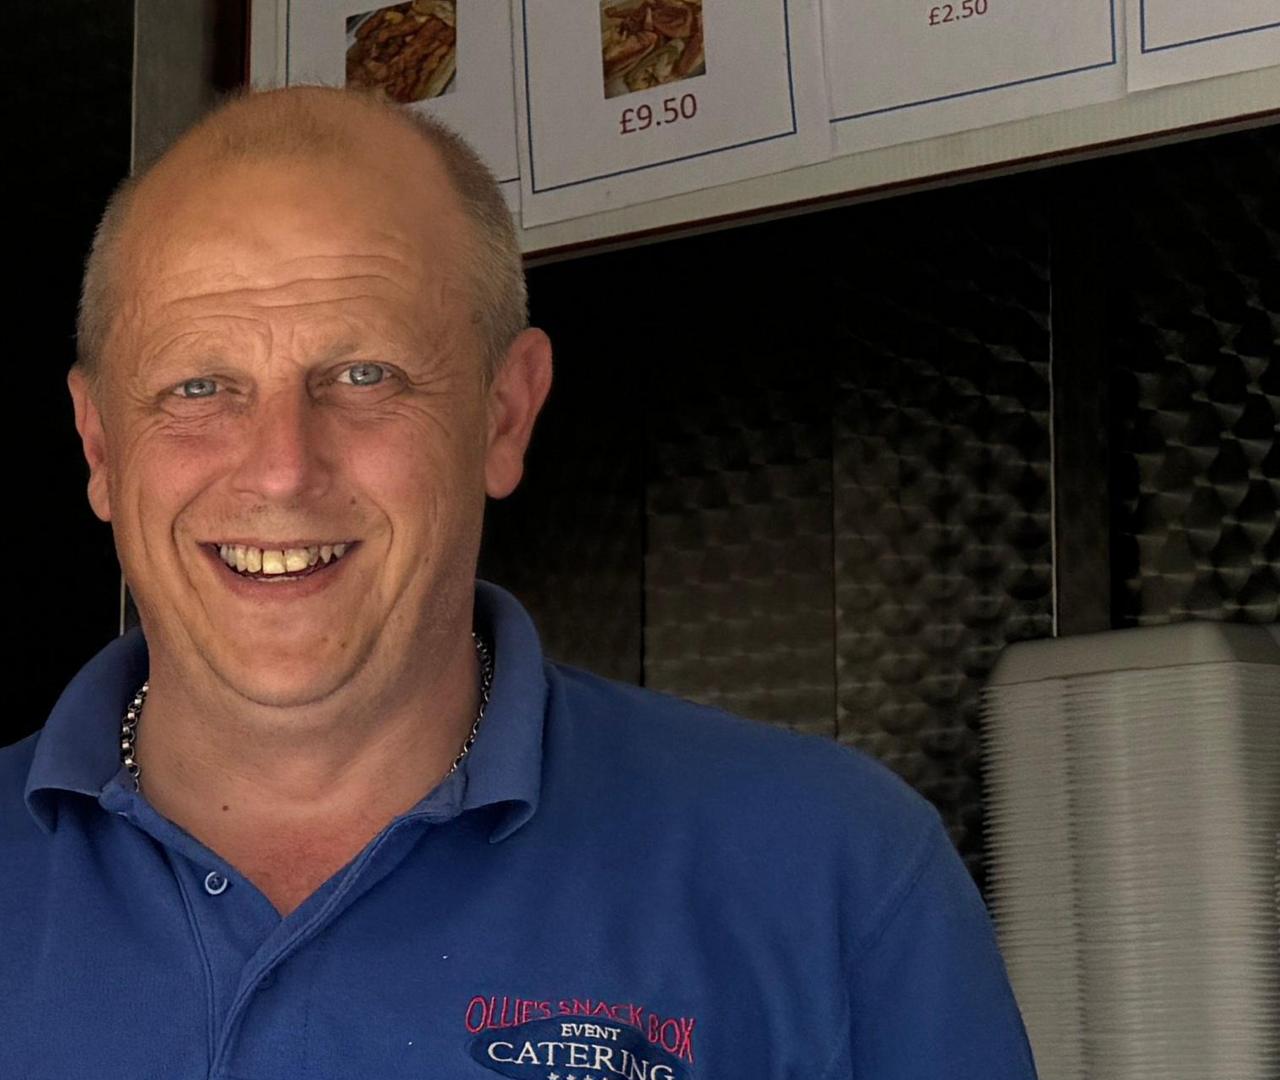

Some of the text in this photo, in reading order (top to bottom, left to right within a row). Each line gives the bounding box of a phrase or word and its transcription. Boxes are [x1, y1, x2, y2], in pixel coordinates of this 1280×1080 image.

[928, 0, 988, 26] £2.50
[619, 93, 698, 135] £9.50
[465, 996, 696, 1063] OLLIE'S SNACK BOX
[561, 1023, 620, 1041] EVENT
